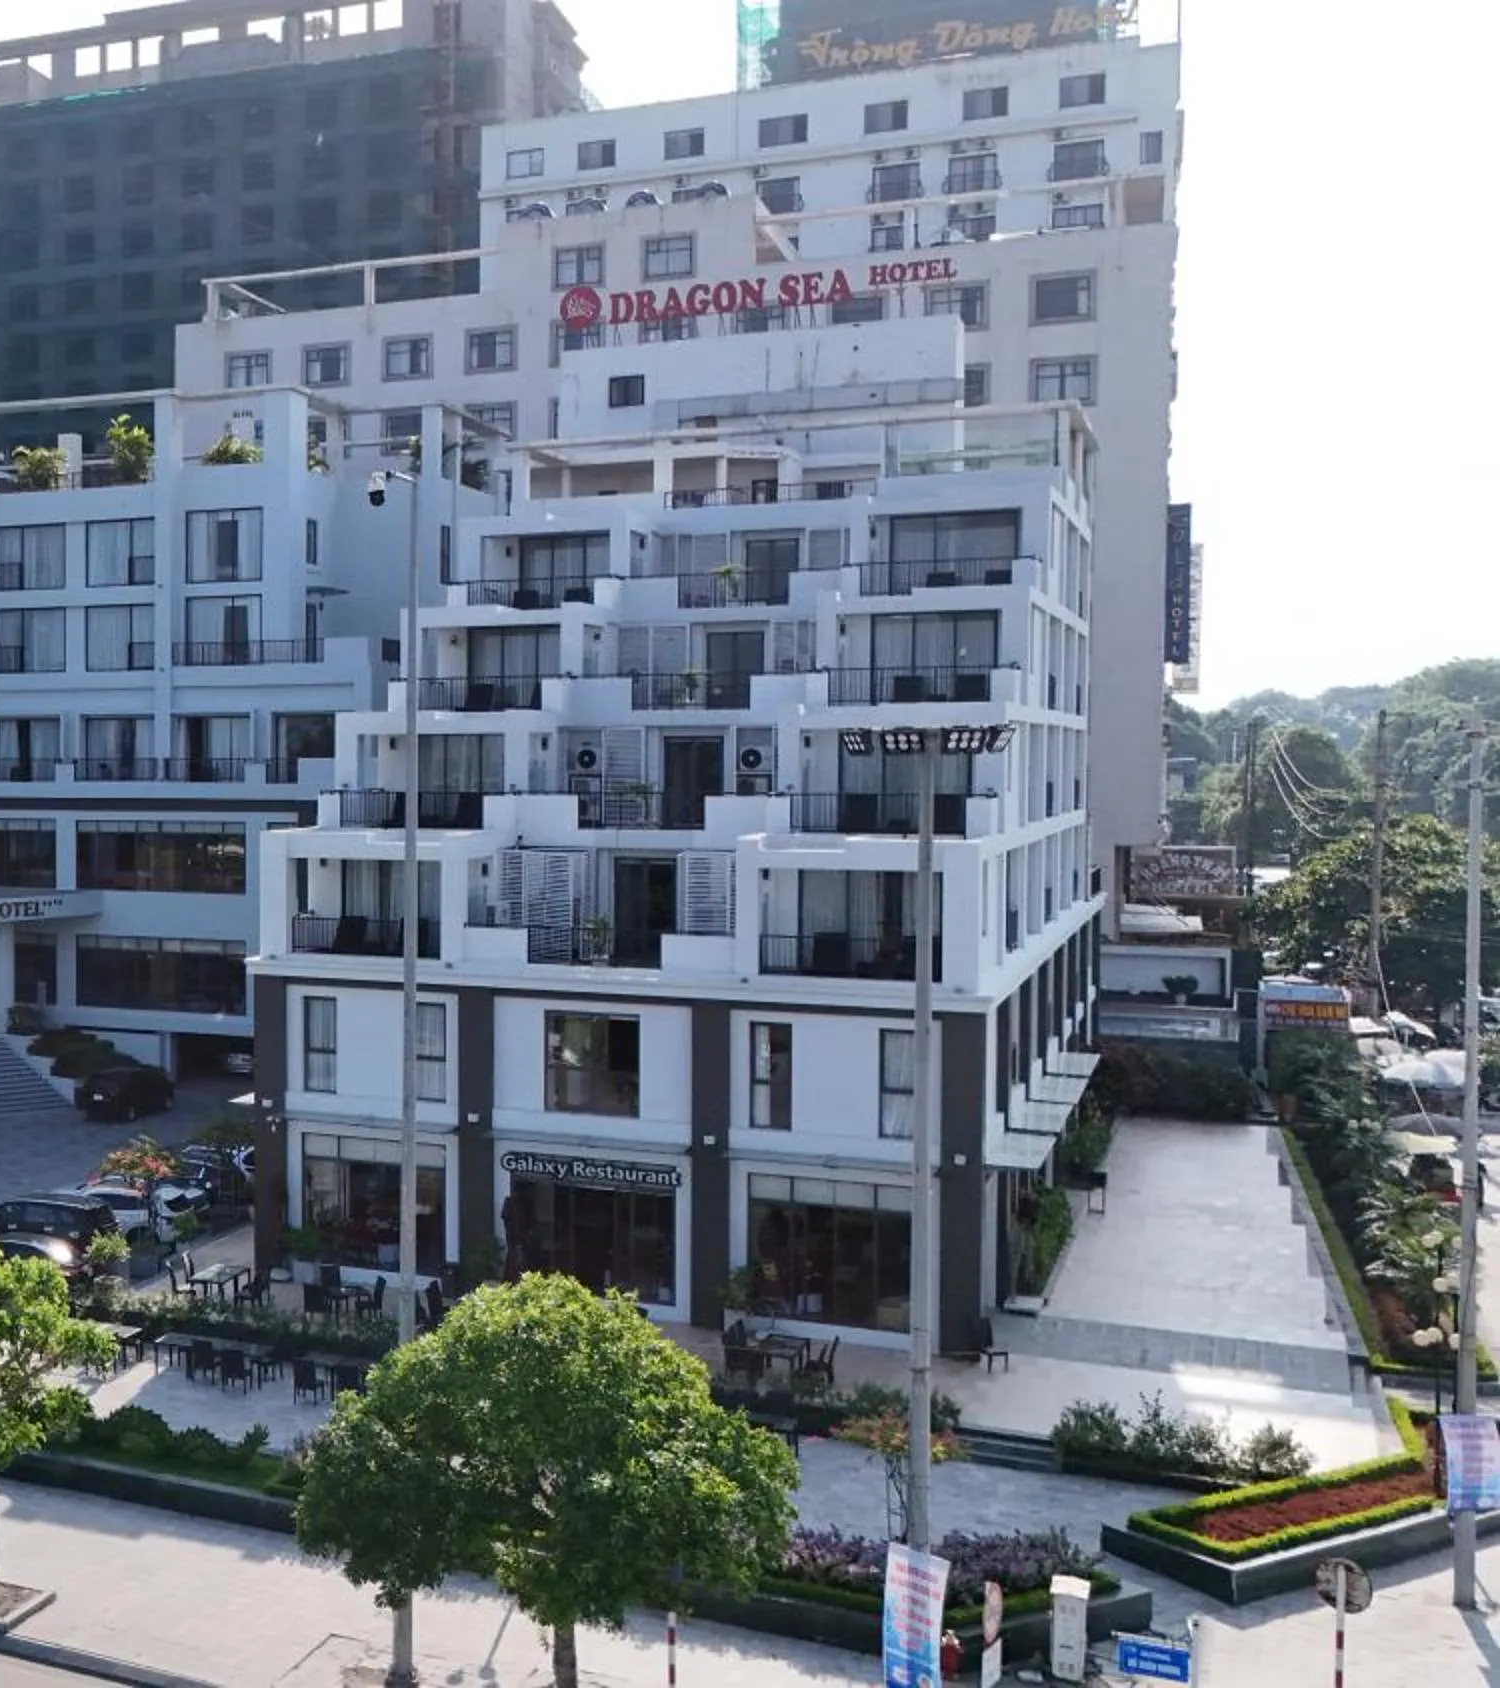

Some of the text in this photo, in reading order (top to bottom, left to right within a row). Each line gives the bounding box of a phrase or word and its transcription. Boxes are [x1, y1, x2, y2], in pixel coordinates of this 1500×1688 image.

[609, 258, 959, 325] DRAGON SEA HOTEL
[502, 1154, 679, 1185] Galaxy Restaurant
